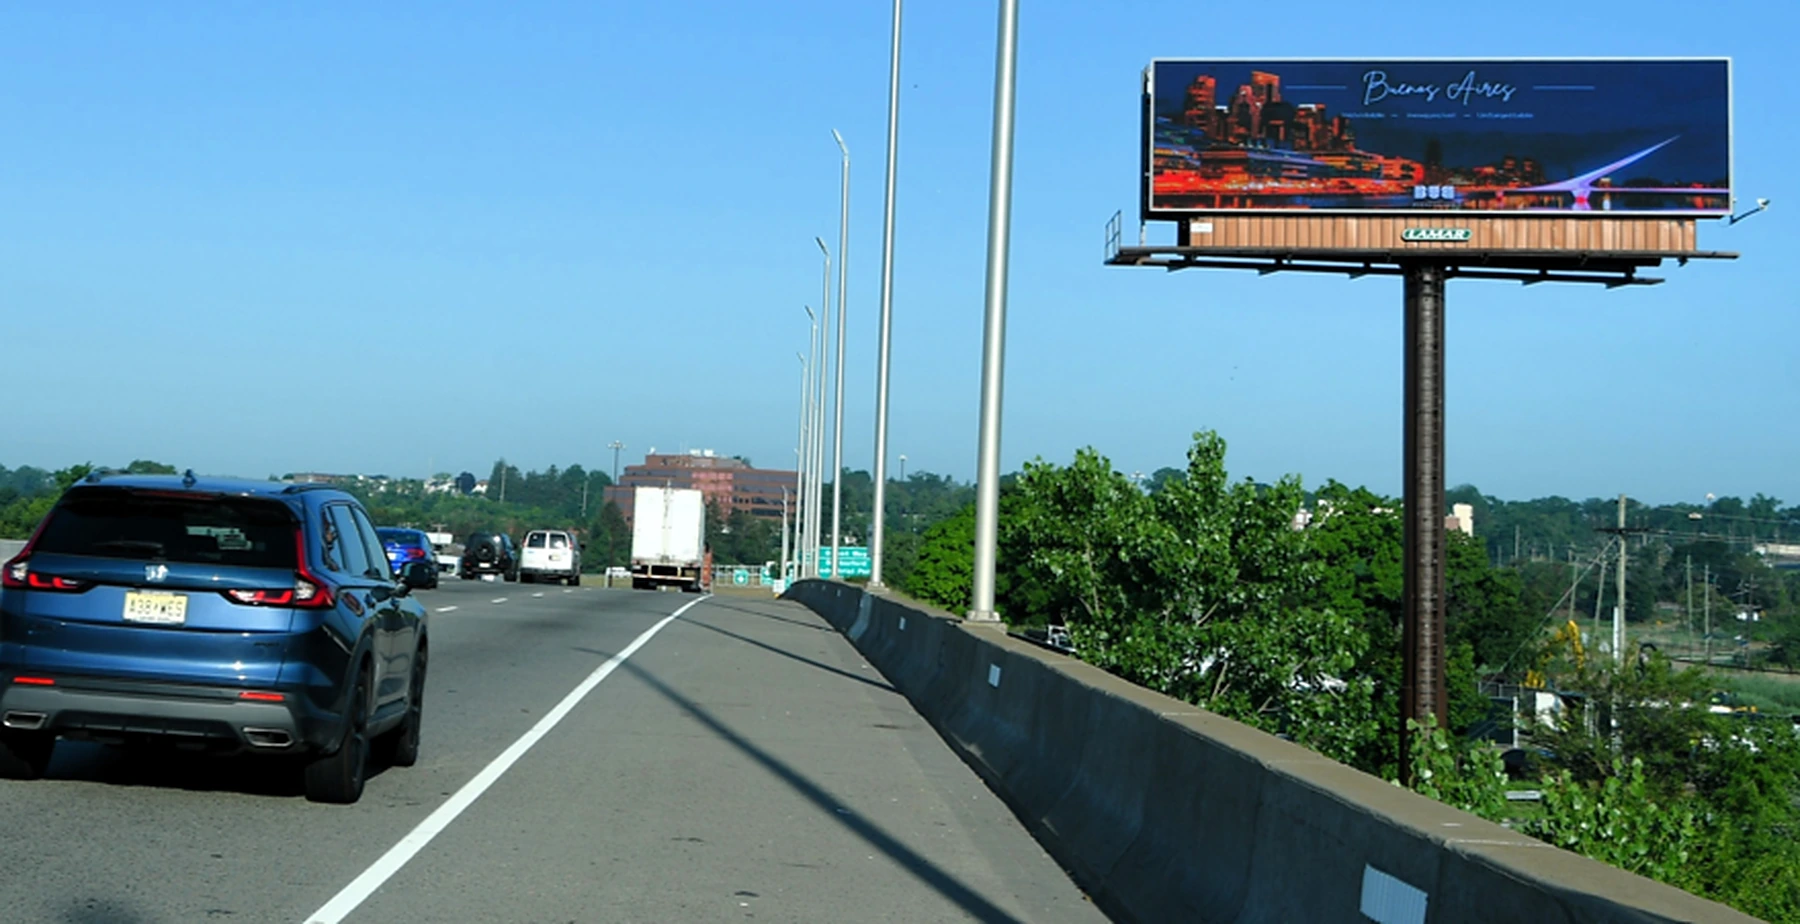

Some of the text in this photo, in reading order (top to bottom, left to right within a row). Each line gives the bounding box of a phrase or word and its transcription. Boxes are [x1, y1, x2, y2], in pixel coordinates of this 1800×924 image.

[1363, 70, 1517, 106] Buenos Aires
[1407, 229, 1466, 239] LAMAR
